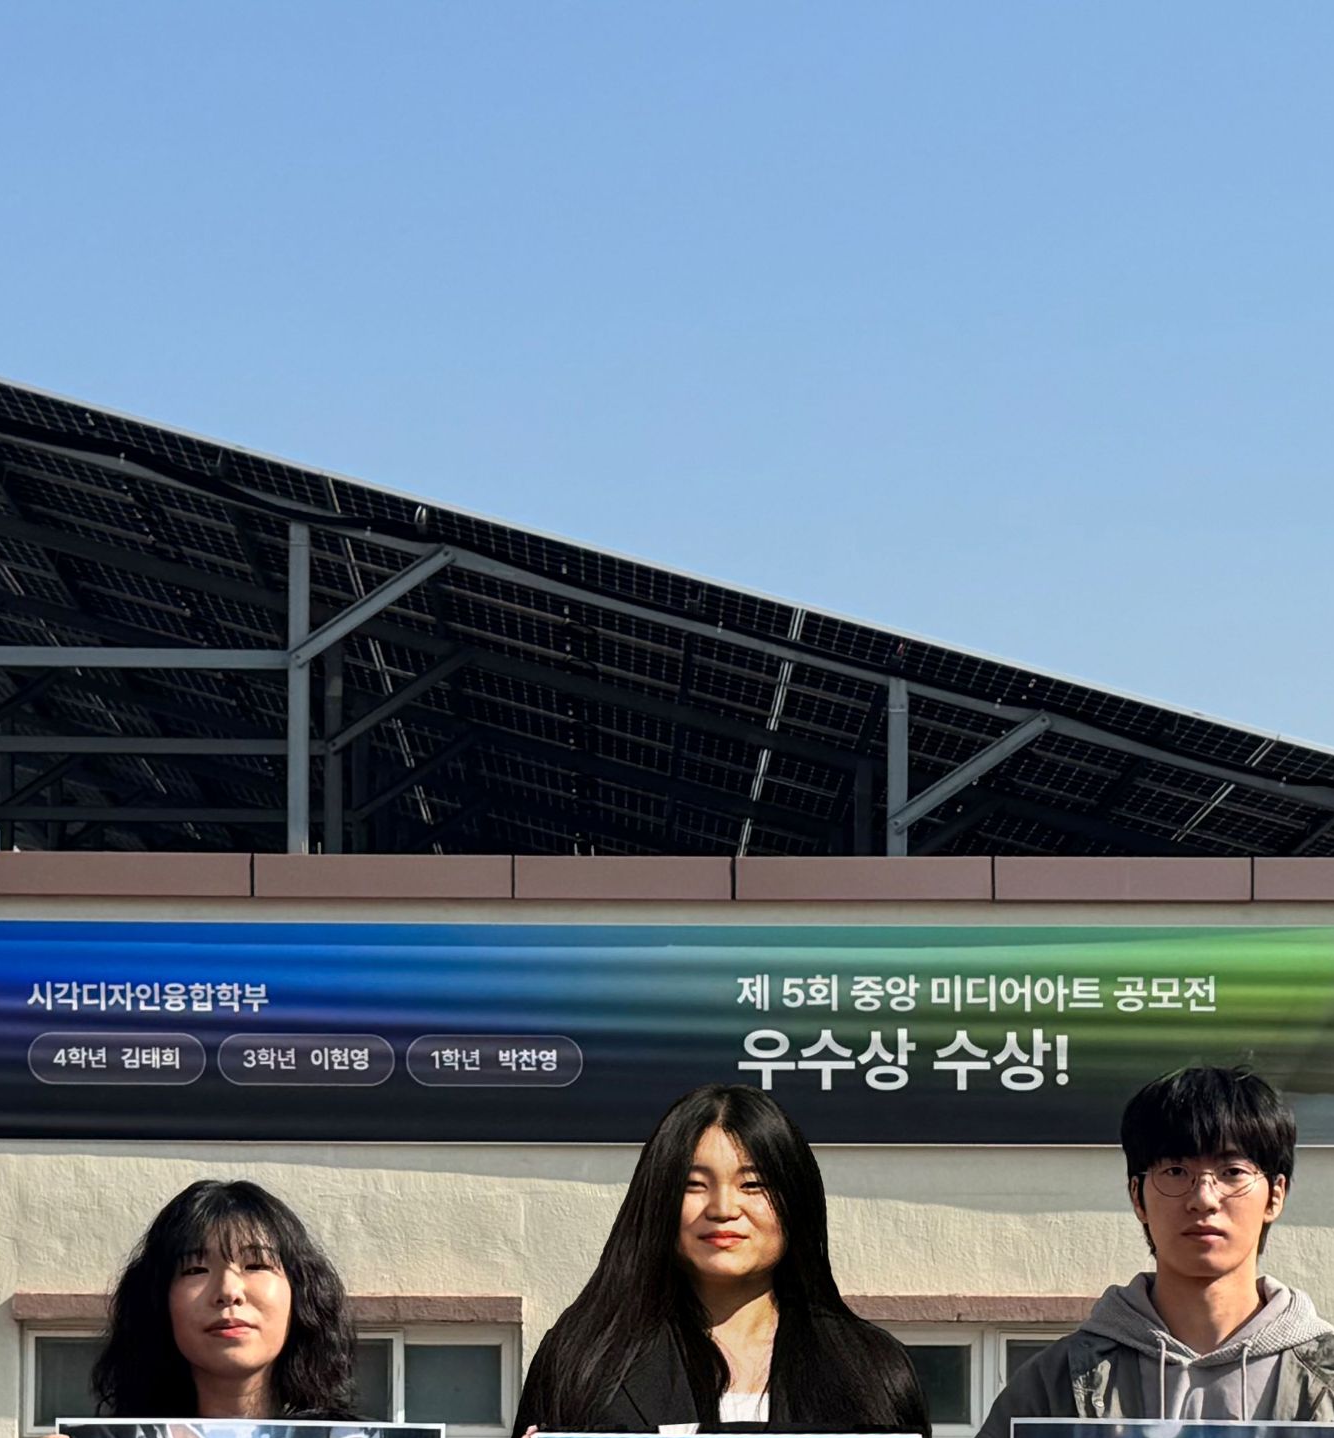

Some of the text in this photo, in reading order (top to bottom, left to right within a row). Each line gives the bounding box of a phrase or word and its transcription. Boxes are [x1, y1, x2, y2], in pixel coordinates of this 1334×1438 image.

[27, 981, 269, 1013] 시각디자인융합학부
[736, 974, 1217, 1013] 제 5회 중앙 미디어아트 공모전
[53, 1047, 181, 1069] 4학년 김태희
[242, 1048, 370, 1071] 3학년 이현영
[430, 1049, 558, 1072] 1학년 박찬영
[737, 1028, 1069, 1091] 우수상 수상!
